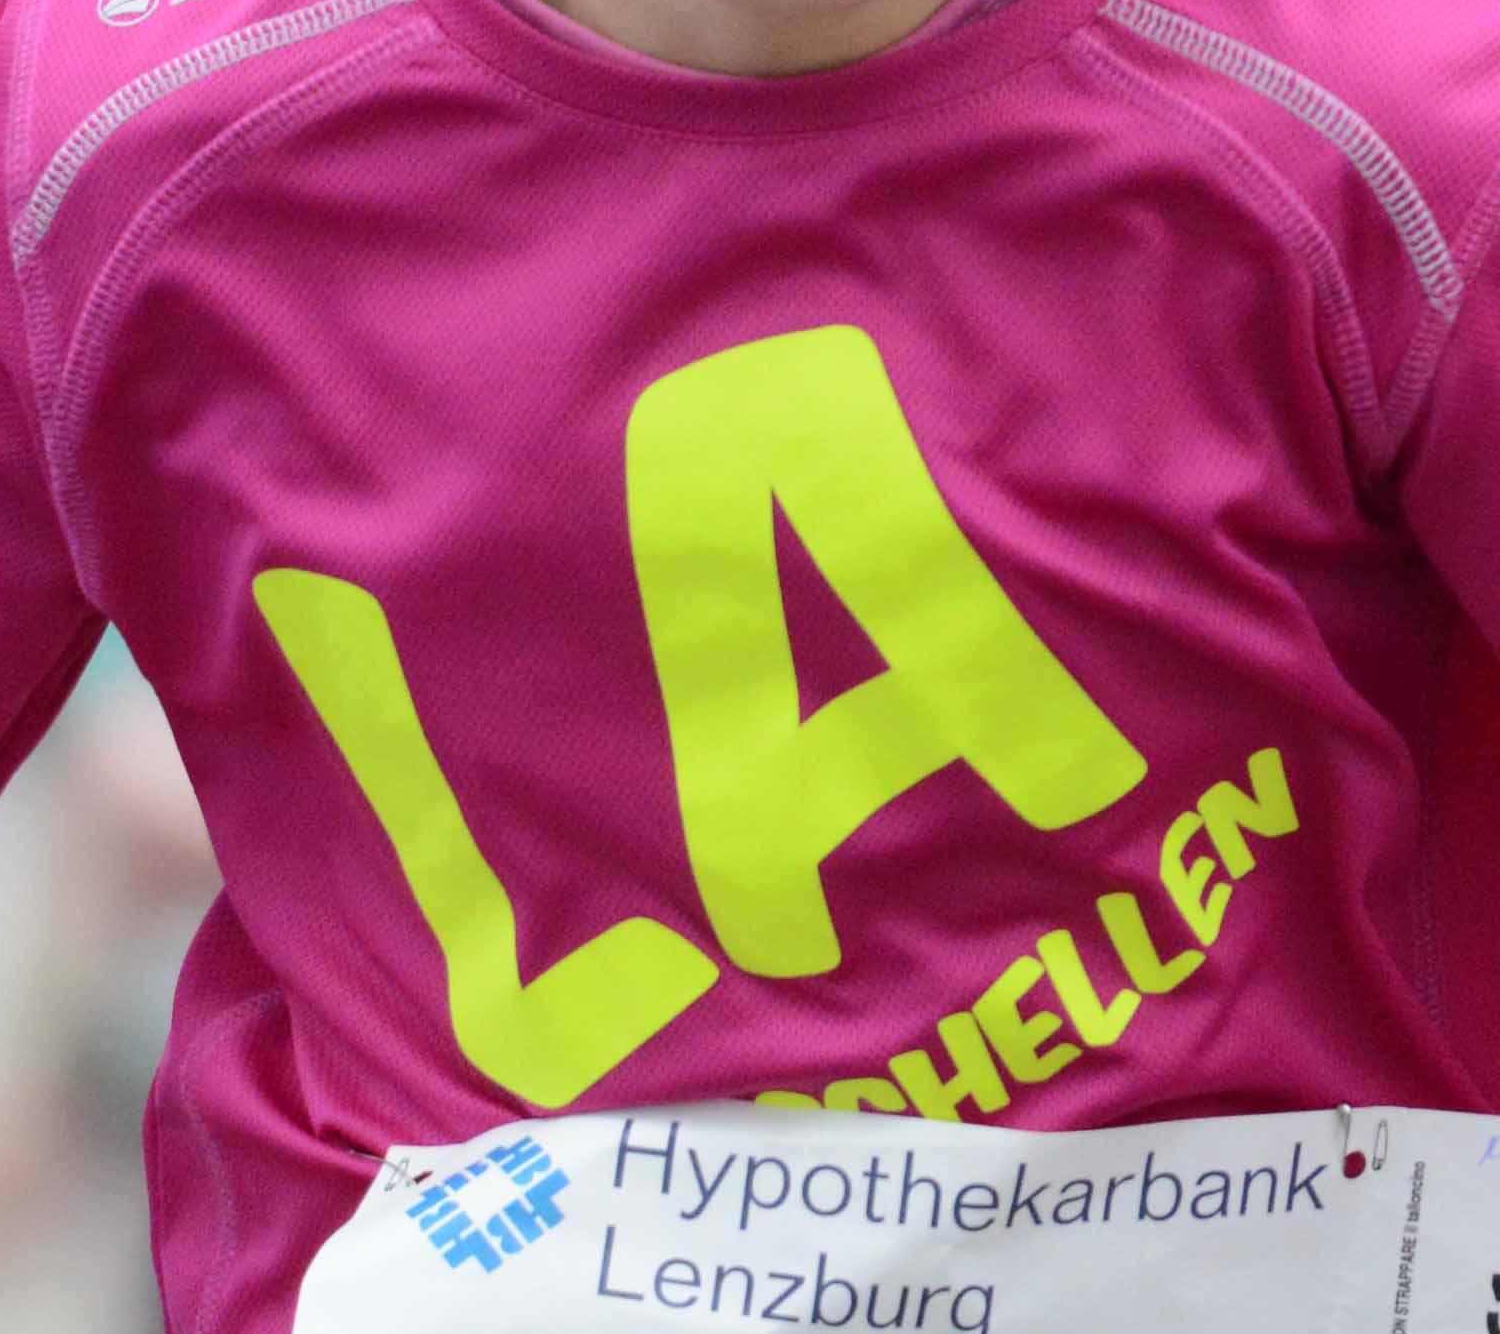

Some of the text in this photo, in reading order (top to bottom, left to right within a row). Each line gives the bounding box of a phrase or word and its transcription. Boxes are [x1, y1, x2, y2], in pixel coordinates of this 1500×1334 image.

[253, 324, 1148, 1107] LA
[612, 1117, 1328, 1233] Hypothekarbank
[1405, 1161, 1426, 1224] talloncino
[1394, 1237, 1418, 1317] STRAPPARE
